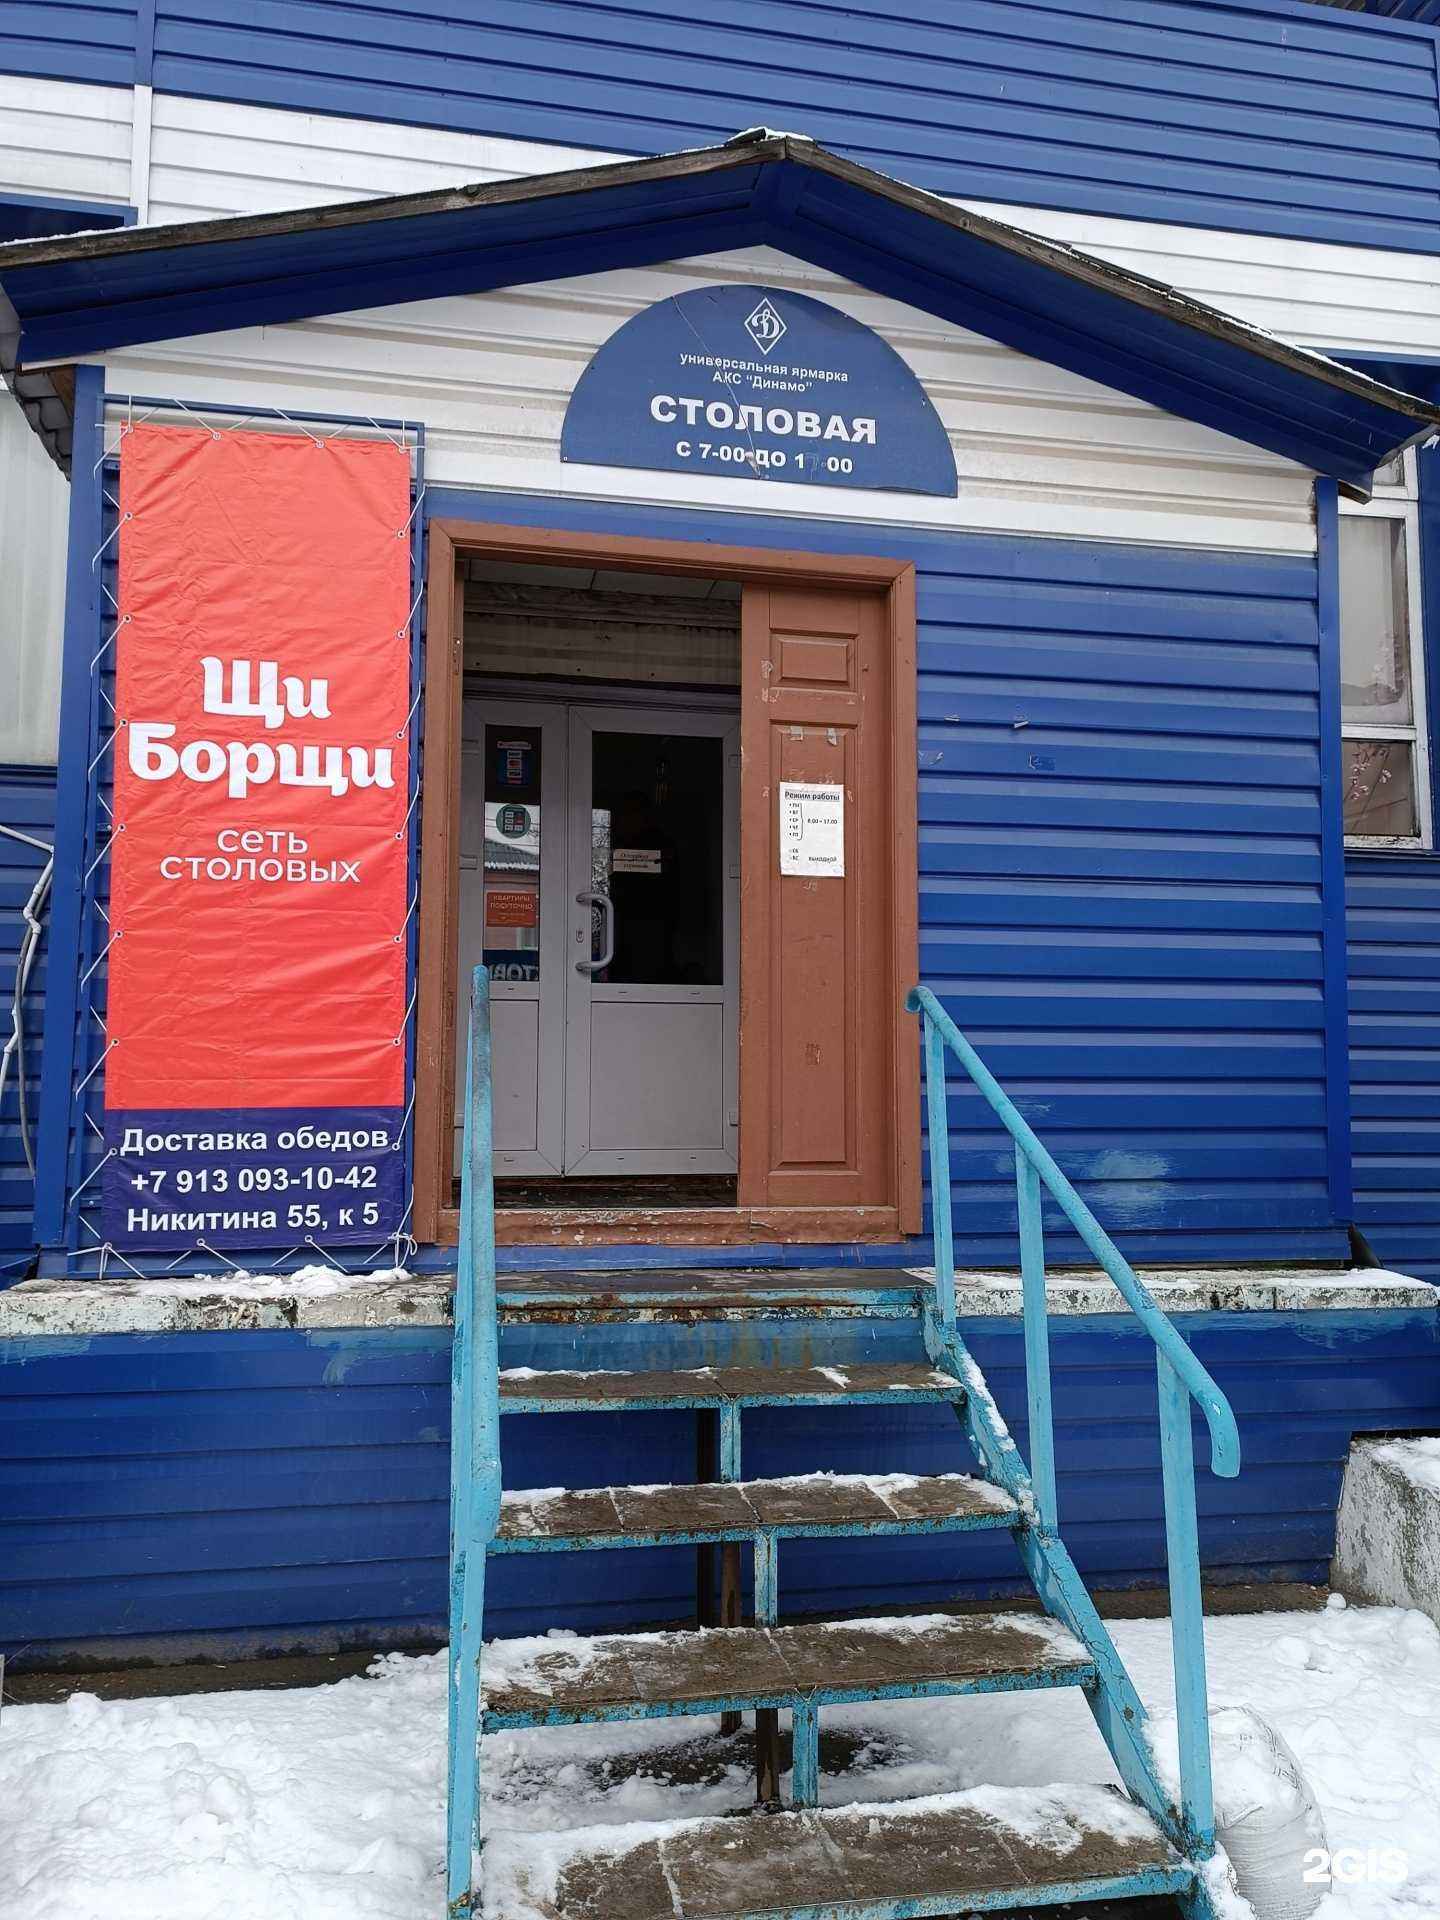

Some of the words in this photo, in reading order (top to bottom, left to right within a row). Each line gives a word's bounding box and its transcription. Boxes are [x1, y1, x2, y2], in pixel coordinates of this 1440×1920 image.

[679, 352, 788, 375] универсальная
[791, 366, 848, 382] ярмарка
[712, 371, 742, 385] АКС
[650, 395, 877, 445] СТОЛОВАЯ
[699, 443, 745, 463] 7-00
[200, 656, 332, 729] Щи
[128, 722, 395, 798] Борщи
[784, 791, 811, 800] Режим
[812, 793, 840, 802] работы
[217, 829, 308, 854] сеть
[120, 1128, 267, 1156] Доставка
[277, 1126, 389, 1152] обедов
[131, 1170, 167, 1193] +7
[176, 1169, 228, 1193] 913
[238, 1166, 377, 1191] 093-10-42
[127, 1208, 277, 1232] Никитина
[287, 1204, 328, 1230] 55,
[339, 1207, 353, 1226] к
[362, 1202, 379, 1225] 5
